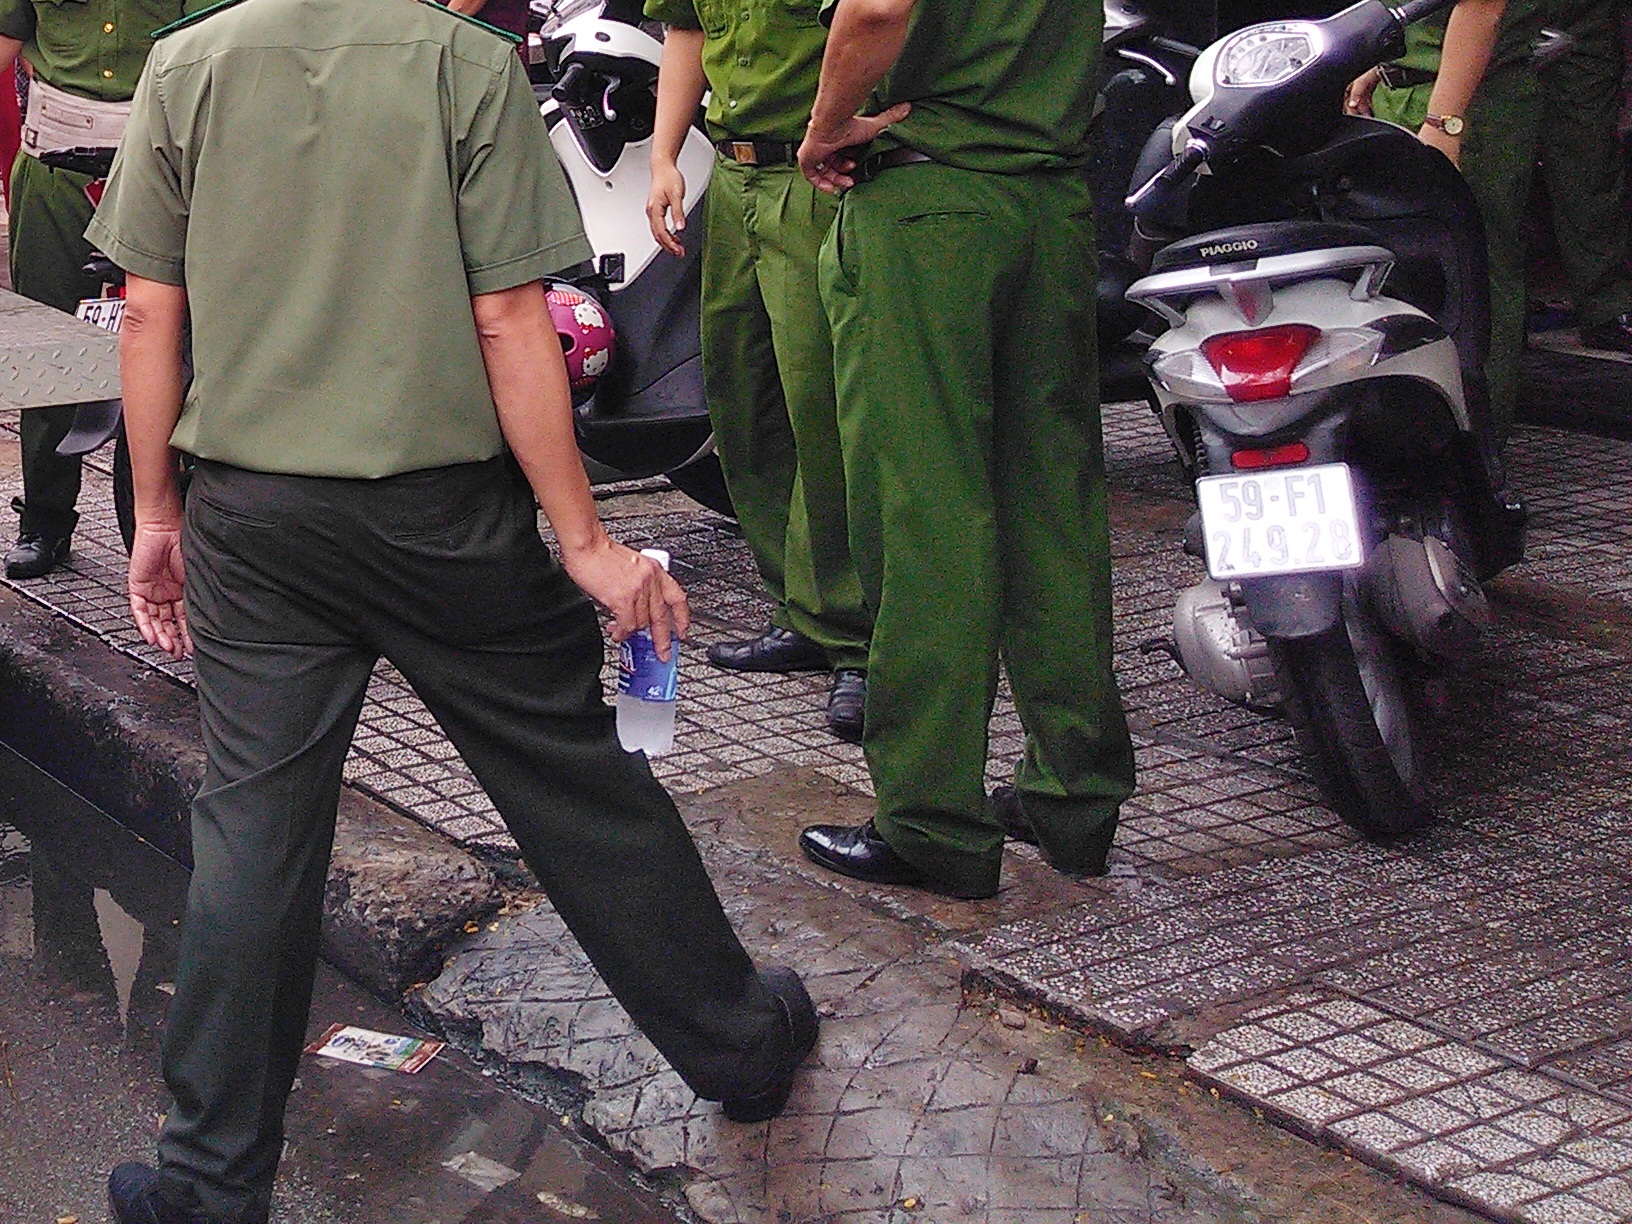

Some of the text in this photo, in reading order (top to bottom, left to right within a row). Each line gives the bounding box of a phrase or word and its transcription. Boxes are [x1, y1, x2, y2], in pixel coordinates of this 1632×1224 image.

[1200, 238, 1258, 258] PIAGGIO
[1219, 472, 1327, 522] 59-F1
[1213, 519, 1352, 573] 249.28
